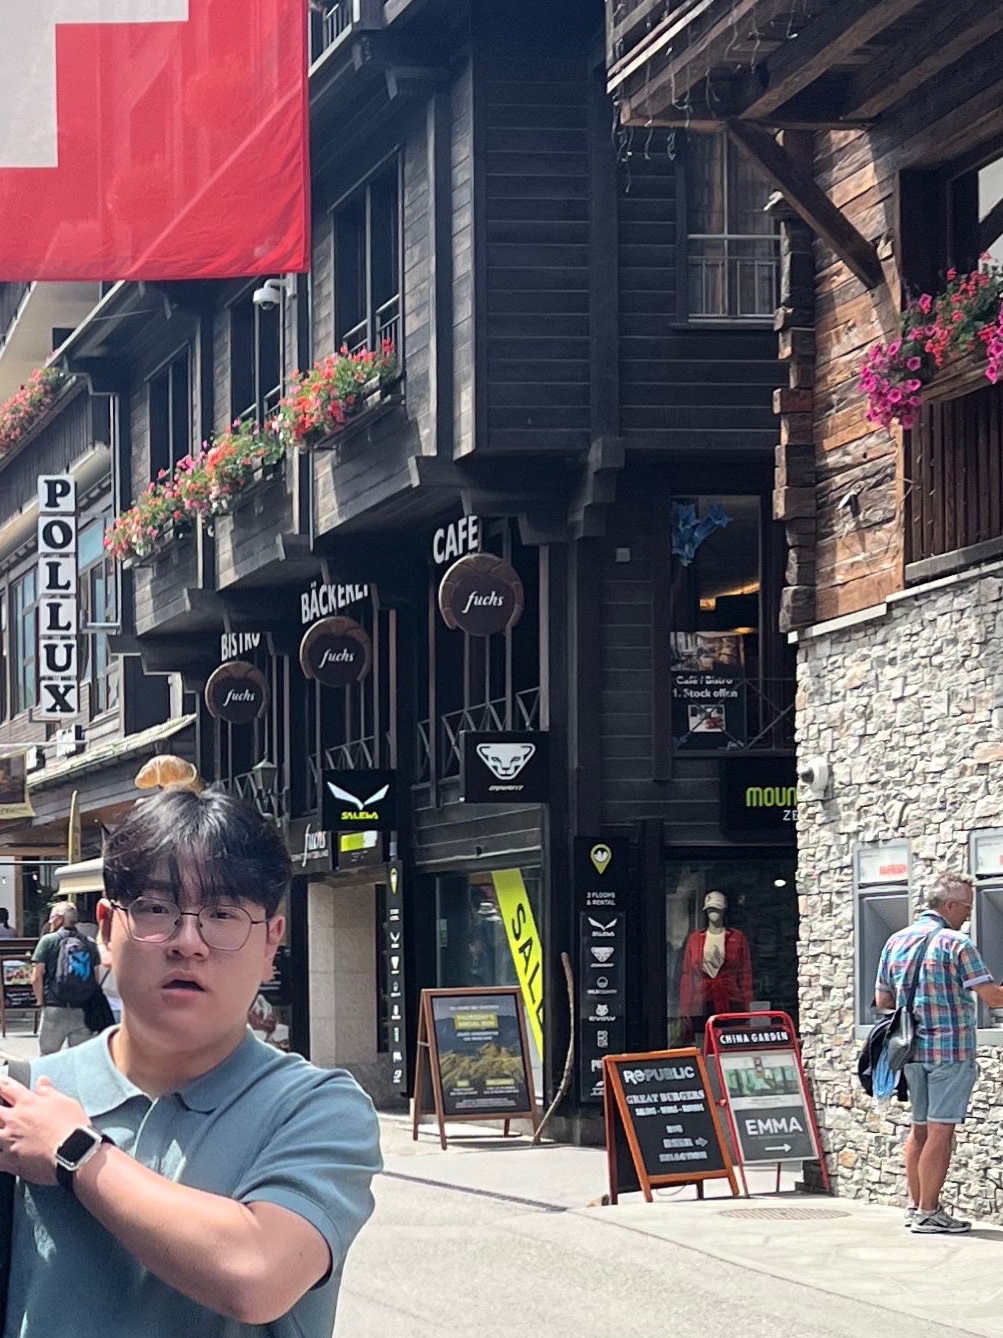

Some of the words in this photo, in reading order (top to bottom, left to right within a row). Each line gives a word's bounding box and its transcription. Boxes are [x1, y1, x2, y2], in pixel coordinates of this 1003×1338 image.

[433, 515, 478, 564] CAFE
[42, 479, 75, 713] POLLUX
[461, 591, 504, 614] fuchs
[317, 648, 355, 669] fuchs
[222, 689, 256, 707] fuchs
[683, 688, 712, 698] Stock
[720, 1033, 750, 1044] CHINA
[751, 1031, 789, 1042] GARDEN
[626, 1094, 658, 1104] GREAT
[660, 1090, 705, 1102] BURGERS
[746, 1117, 803, 1135] EMMA
